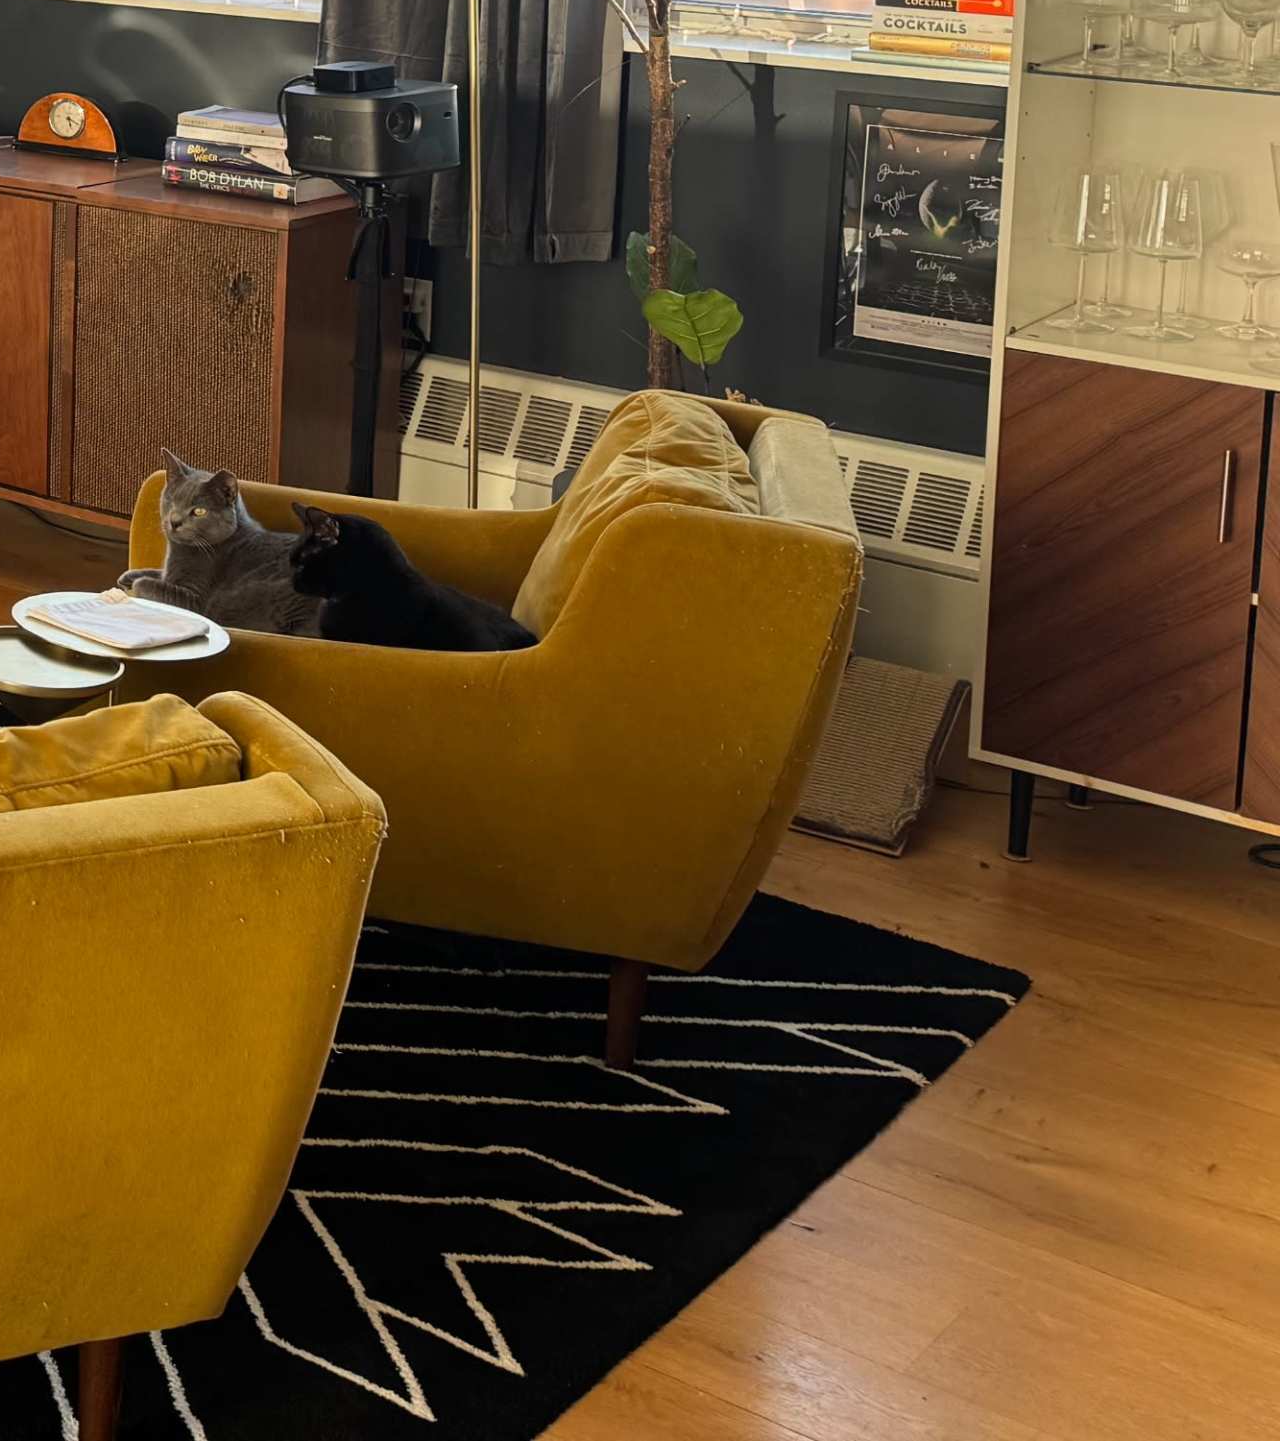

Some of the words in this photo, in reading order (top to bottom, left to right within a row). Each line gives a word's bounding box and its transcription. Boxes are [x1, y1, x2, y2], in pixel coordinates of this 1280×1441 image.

[883, 17, 968, 34] COCKTAILS
[190, 168, 216, 185] BOB
[220, 172, 265, 191] DYLAN
